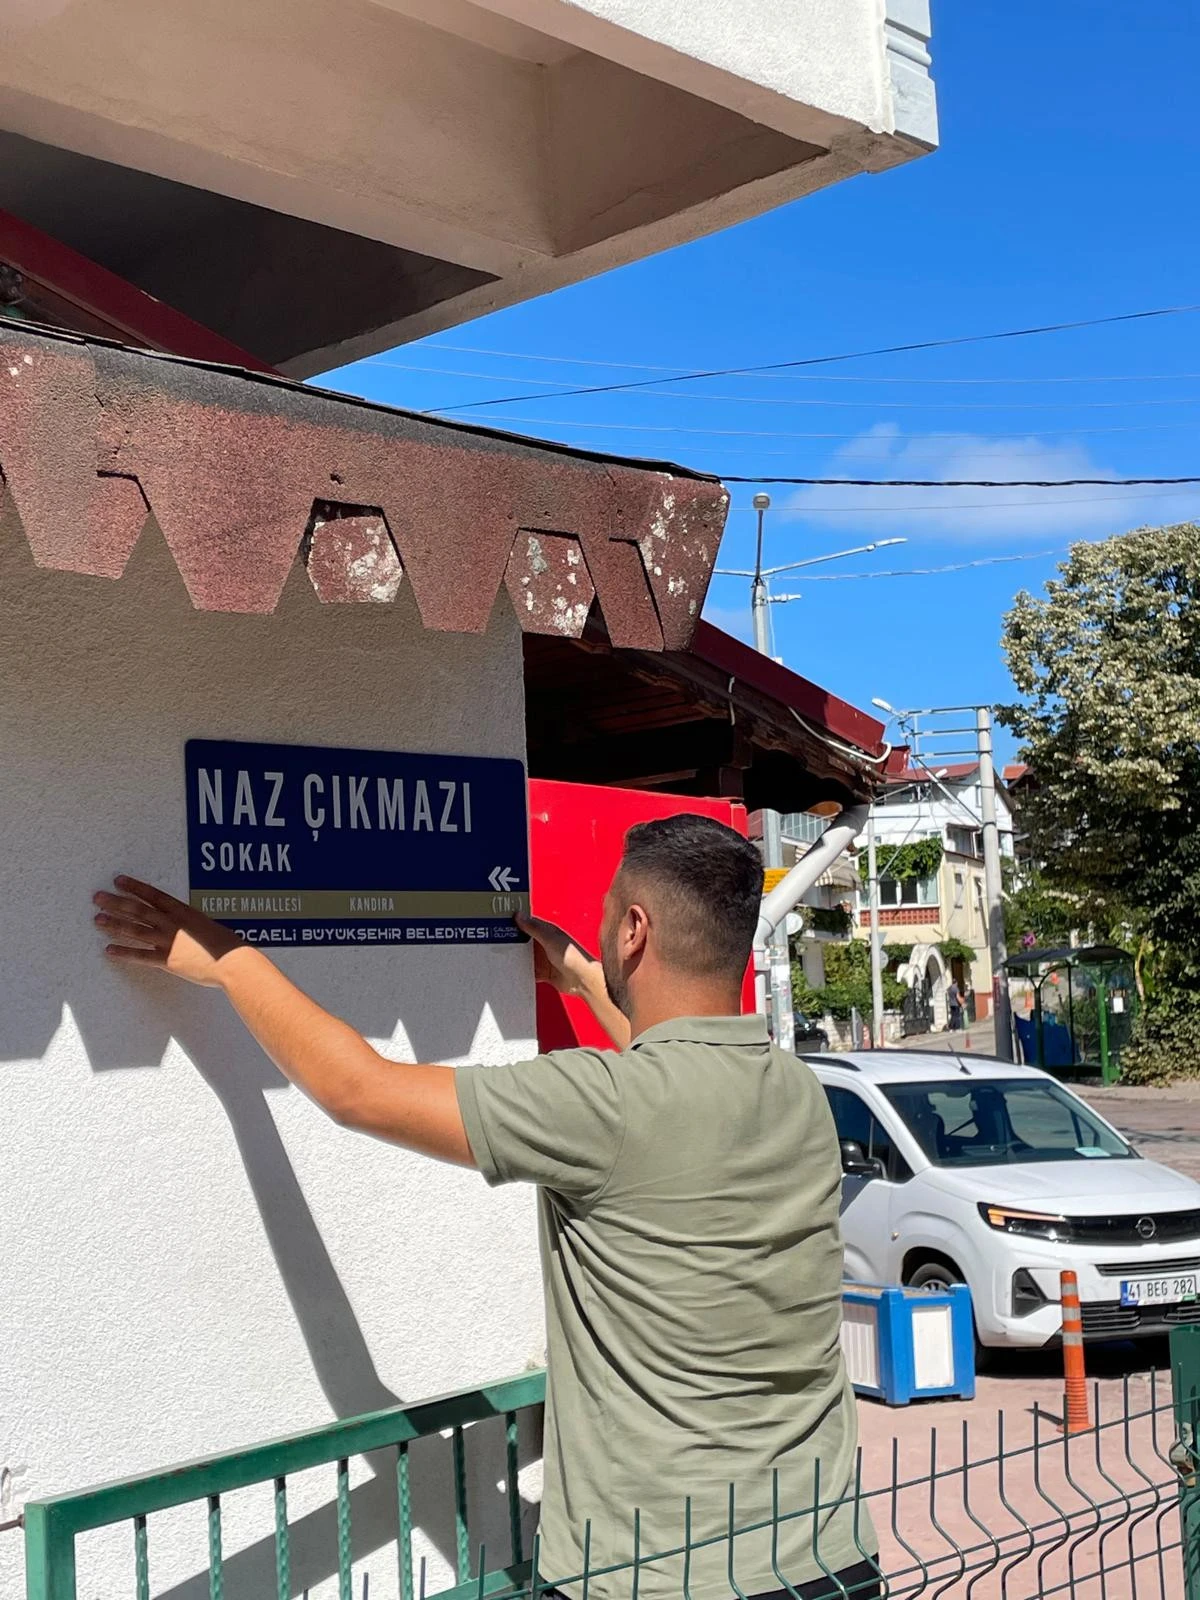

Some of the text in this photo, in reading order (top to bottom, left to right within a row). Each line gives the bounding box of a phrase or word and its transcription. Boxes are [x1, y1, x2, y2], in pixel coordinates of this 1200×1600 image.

[198, 768, 472, 842] NAZ ÇIKMAZI
[201, 841, 292, 872] SOKAK
[201, 895, 302, 913] KERPE MAHALLESİ
[349, 897, 395, 912] KANDIRA
[1128, 1284, 1141, 1299] 41
[1147, 1281, 1168, 1298] BEG
[1173, 1278, 1194, 1295] 282
